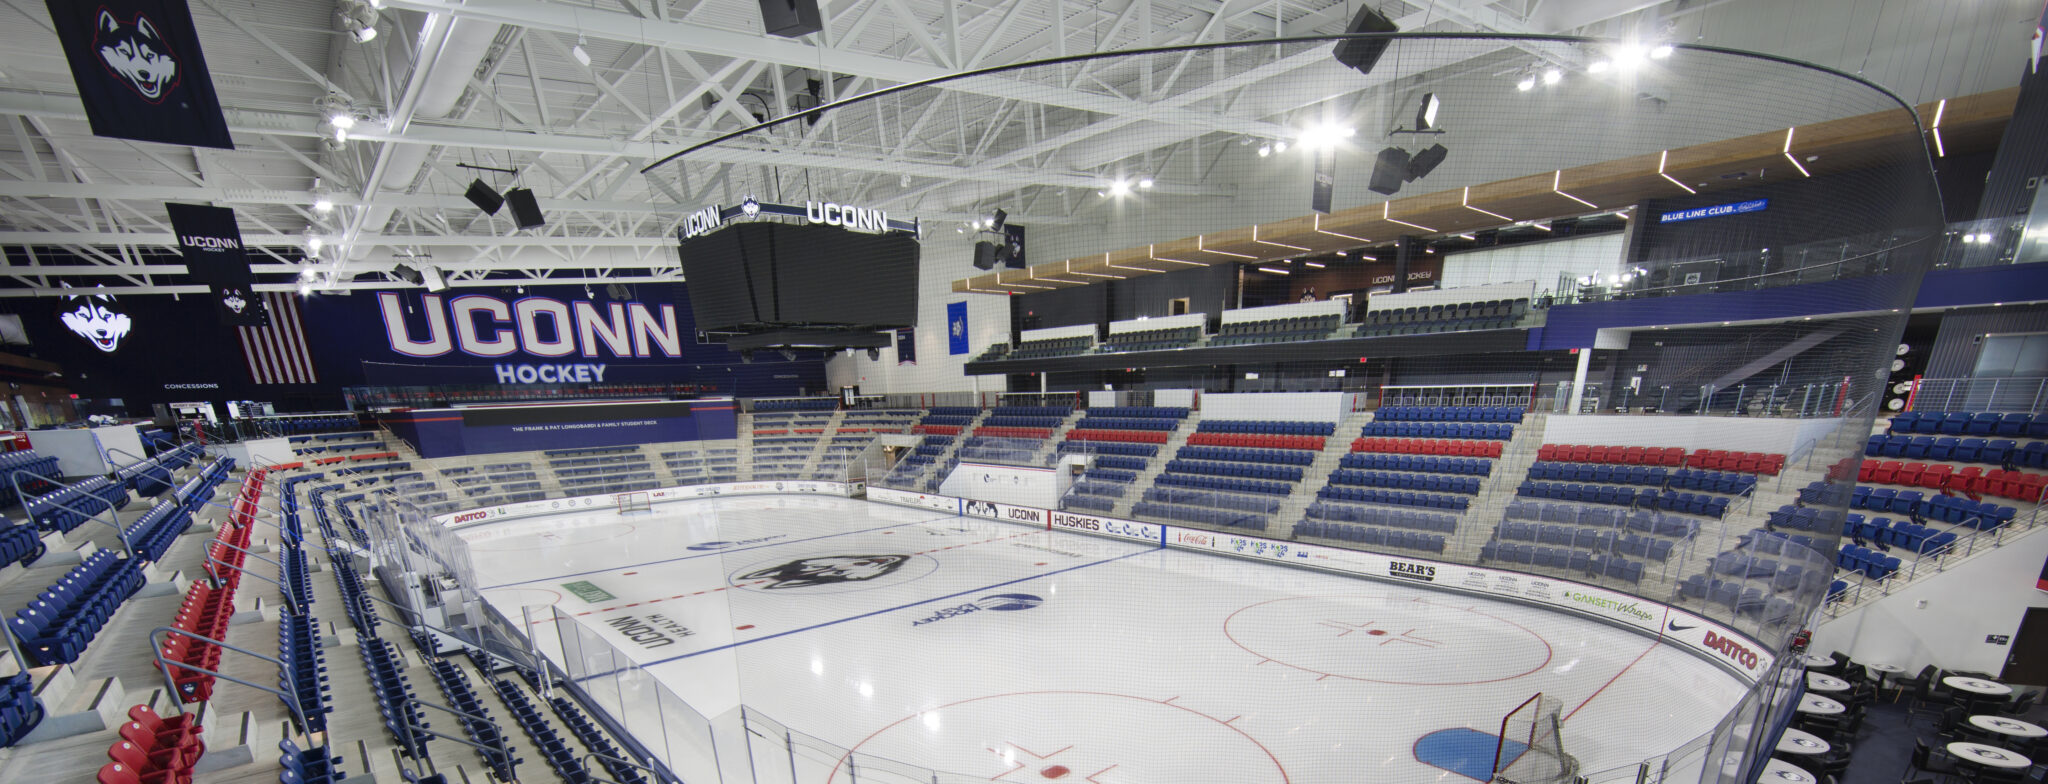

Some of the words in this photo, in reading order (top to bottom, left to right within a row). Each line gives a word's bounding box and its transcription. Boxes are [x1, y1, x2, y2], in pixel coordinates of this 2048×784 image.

[683, 204, 722, 238] UCONN
[806, 200, 888, 232] UCONN
[1661, 212, 1684, 222] BLUE
[1685, 209, 1707, 219] LINE
[182, 235, 239, 249] UCONN
[1371, 274, 1396, 284] UCON
[376, 291, 682, 357] UCONN
[496, 364, 606, 384] HOCKEY
[454, 511, 487, 524] DATTCO
[1008, 507, 1040, 522] UCONN
[1054, 512, 1100, 531] HUSKIES
[1389, 561, 1436, 576] BEAR'S
[1573, 592, 1619, 611] GANSETT
[1616, 602, 1653, 621] Wraps
[603, 615, 675, 650] UCONN
[645, 613, 696, 638] HEALTH
[1702, 630, 1758, 671] DATTCO
